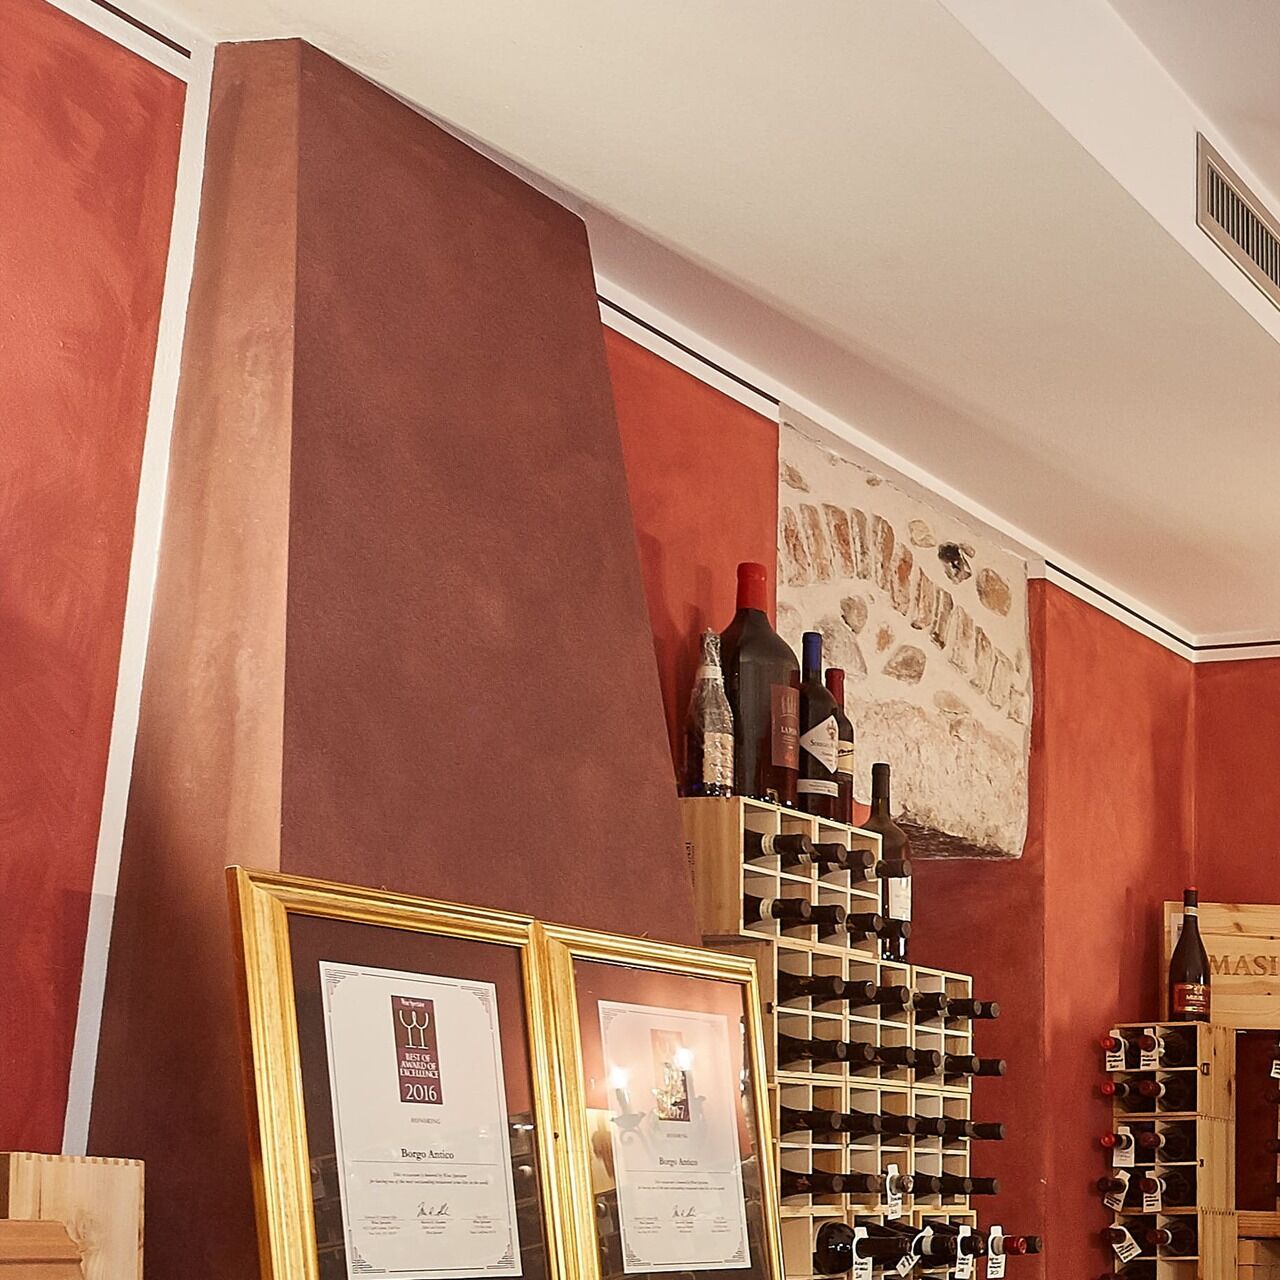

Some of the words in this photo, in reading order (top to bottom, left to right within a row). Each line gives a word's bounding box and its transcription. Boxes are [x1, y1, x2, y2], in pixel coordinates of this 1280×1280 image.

[404, 1083, 438, 1101] 2016
[400, 1148, 427, 1161] Borgo
[428, 1150, 455, 1160] Antico
